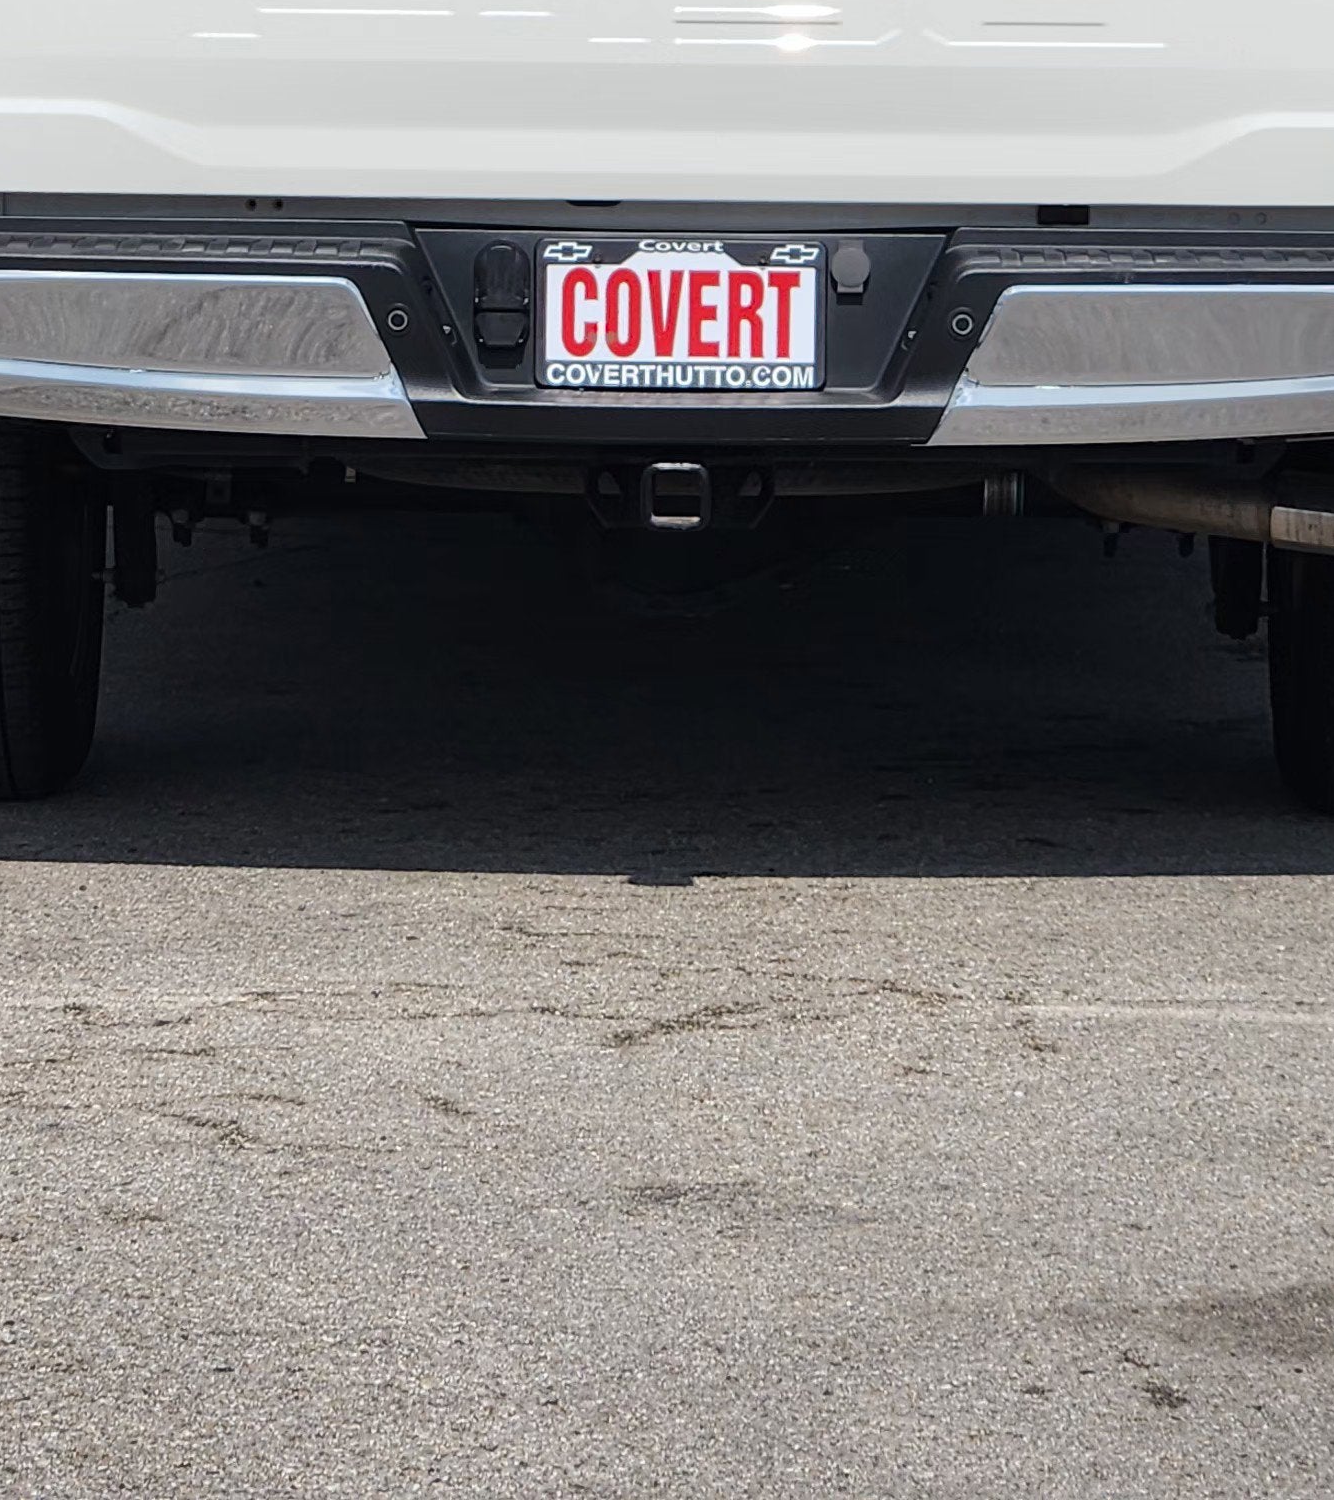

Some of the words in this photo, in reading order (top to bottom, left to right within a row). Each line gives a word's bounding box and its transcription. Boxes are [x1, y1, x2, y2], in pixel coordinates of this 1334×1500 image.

[638, 238, 725, 254] Covert
[560, 266, 801, 359] COVERT
[545, 362, 815, 389] COVERTHUTTO.COM
